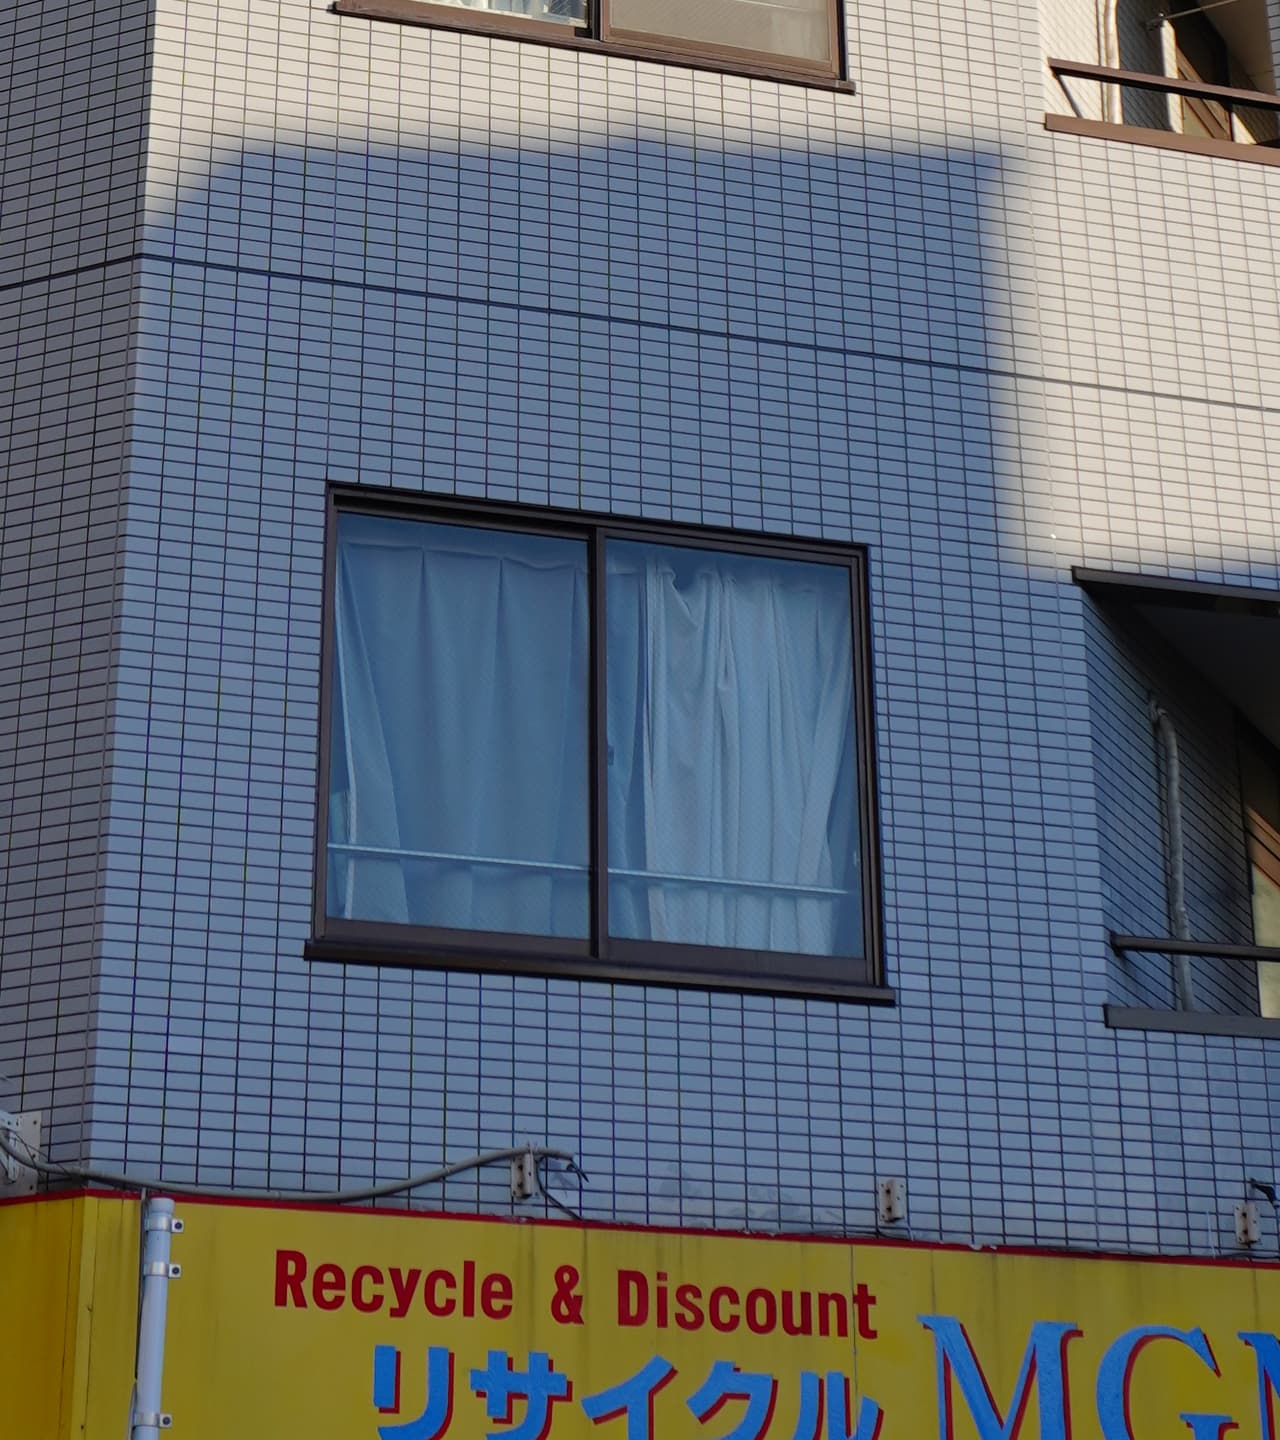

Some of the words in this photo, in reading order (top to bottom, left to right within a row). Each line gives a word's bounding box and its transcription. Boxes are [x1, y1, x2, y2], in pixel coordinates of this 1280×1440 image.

[274, 1249, 513, 1319] Recycle
[550, 1264, 585, 1325] &
[617, 1268, 879, 1340] Discount
